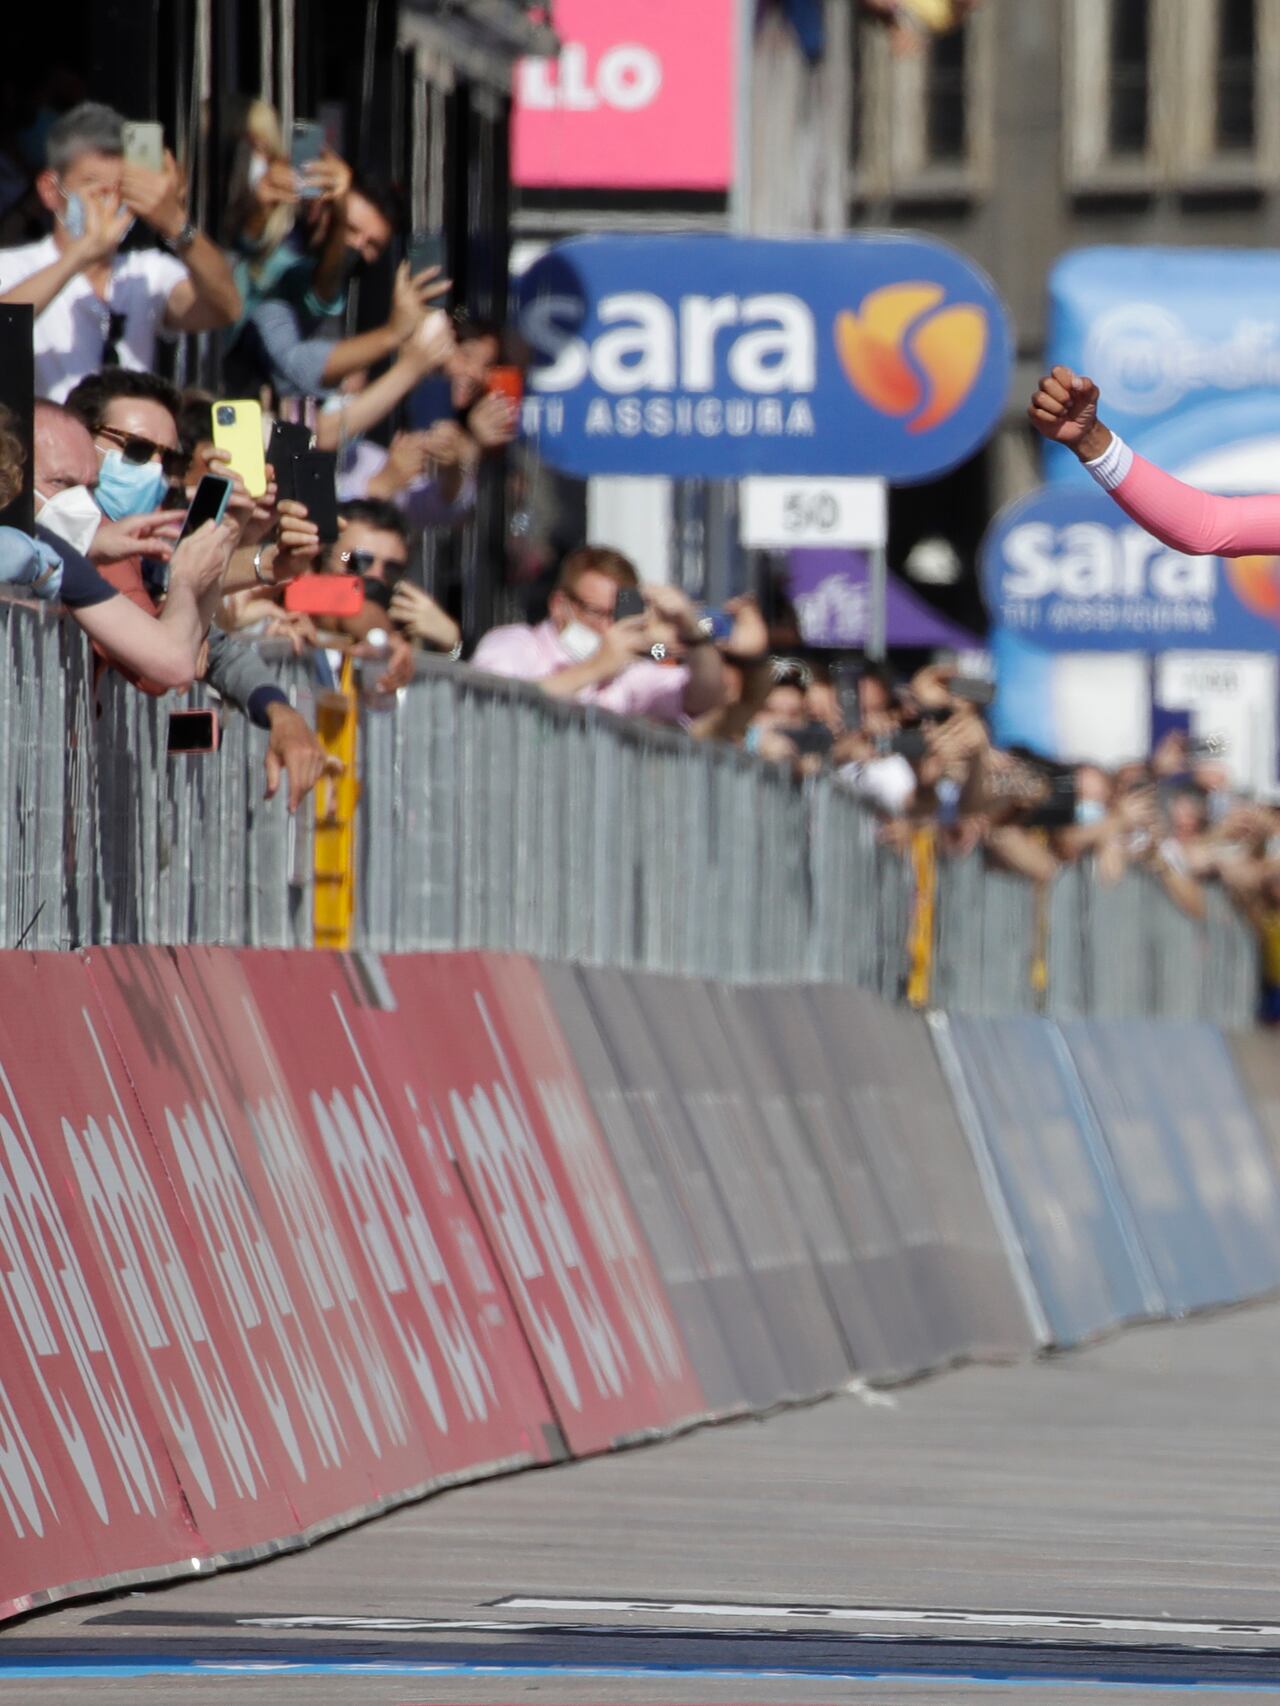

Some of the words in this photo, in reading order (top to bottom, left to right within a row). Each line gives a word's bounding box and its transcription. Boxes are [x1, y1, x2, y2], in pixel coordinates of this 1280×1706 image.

[520, 290, 817, 394] sara
[585, 396, 816, 437] ASSICURA
[1002, 521, 1216, 601] sara
